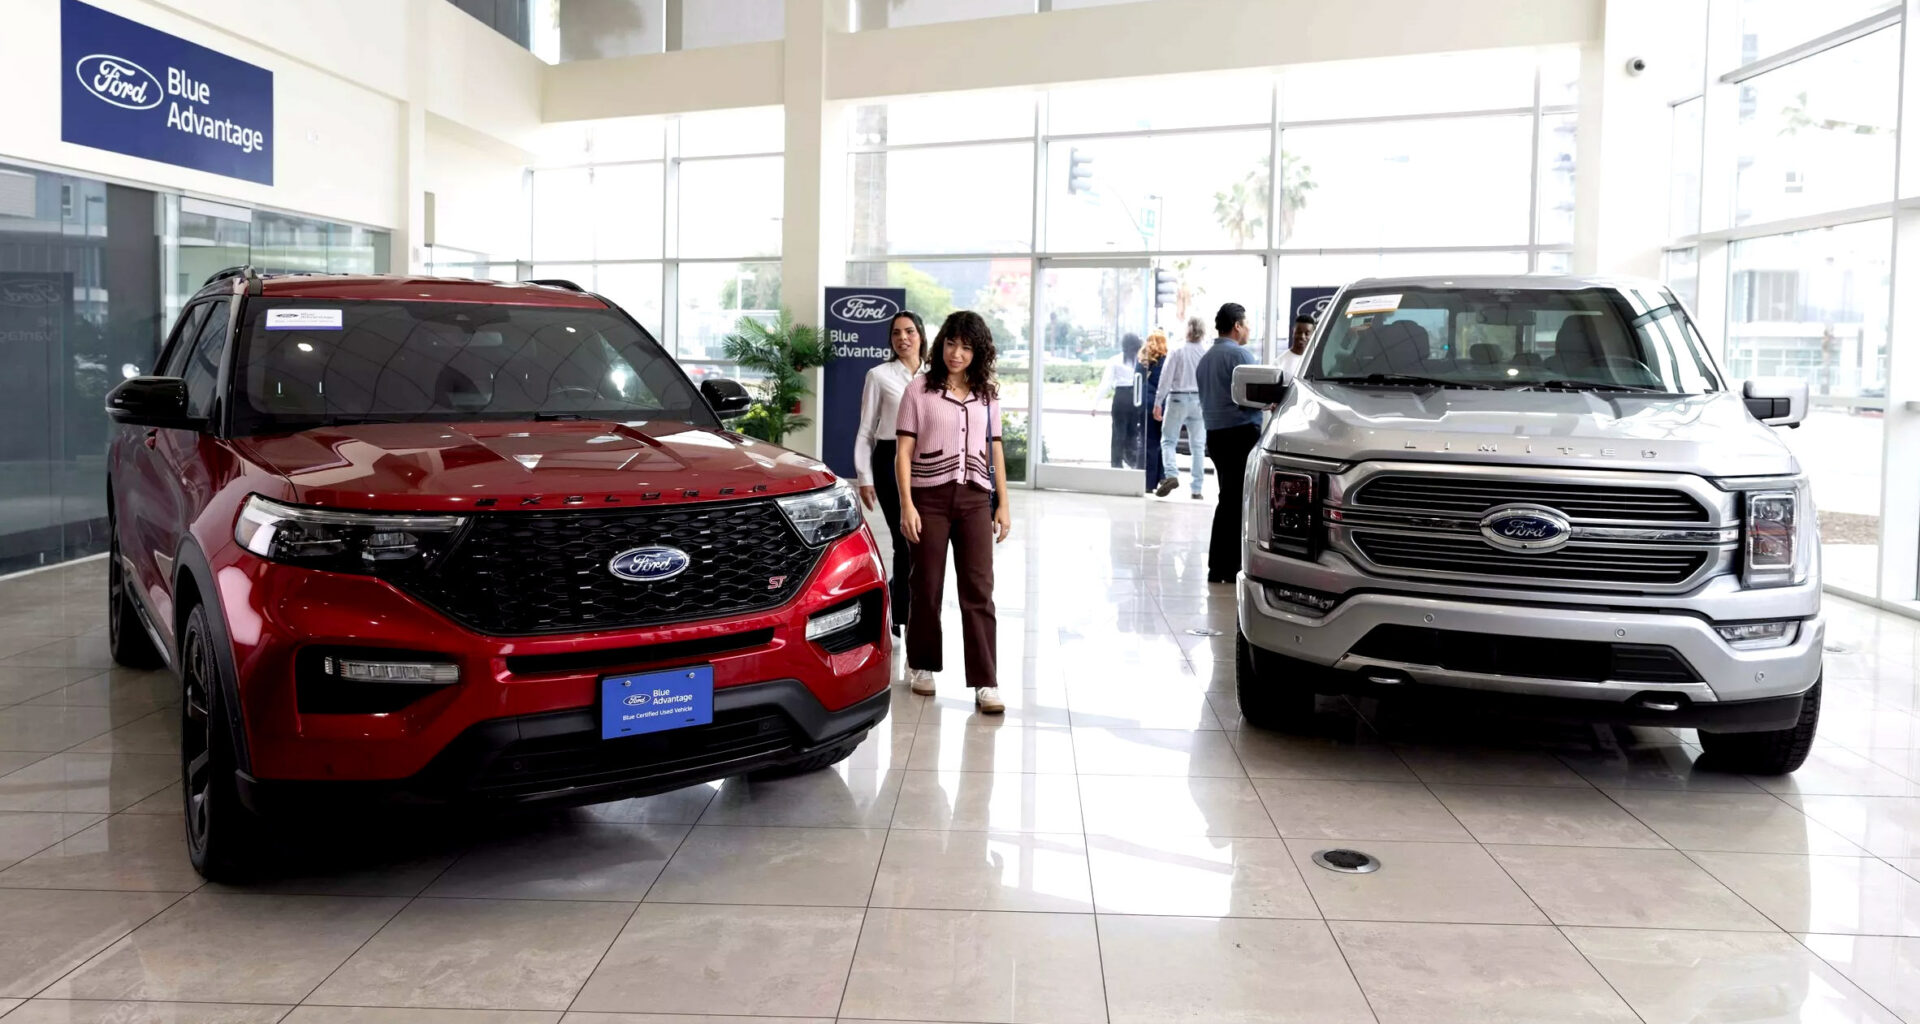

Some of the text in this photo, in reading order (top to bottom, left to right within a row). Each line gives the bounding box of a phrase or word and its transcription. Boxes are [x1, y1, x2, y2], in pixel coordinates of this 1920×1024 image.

[94, 60, 148, 104] Ford
[168, 66, 210, 105] Blue
[167, 101, 264, 153] Advantage
[842, 298, 887, 319] Ford
[830, 329, 859, 343] Blue
[831, 344, 894, 361] Advantag
[1404, 440, 1658, 458] LIMITED
[1504, 519, 1546, 537] Ford
[629, 553, 672, 573] Ford
[767, 575, 788, 590] ST
[628, 695, 645, 704] Ford
[653, 689, 670, 697] Blue
[653, 694, 692, 705] Advantage
